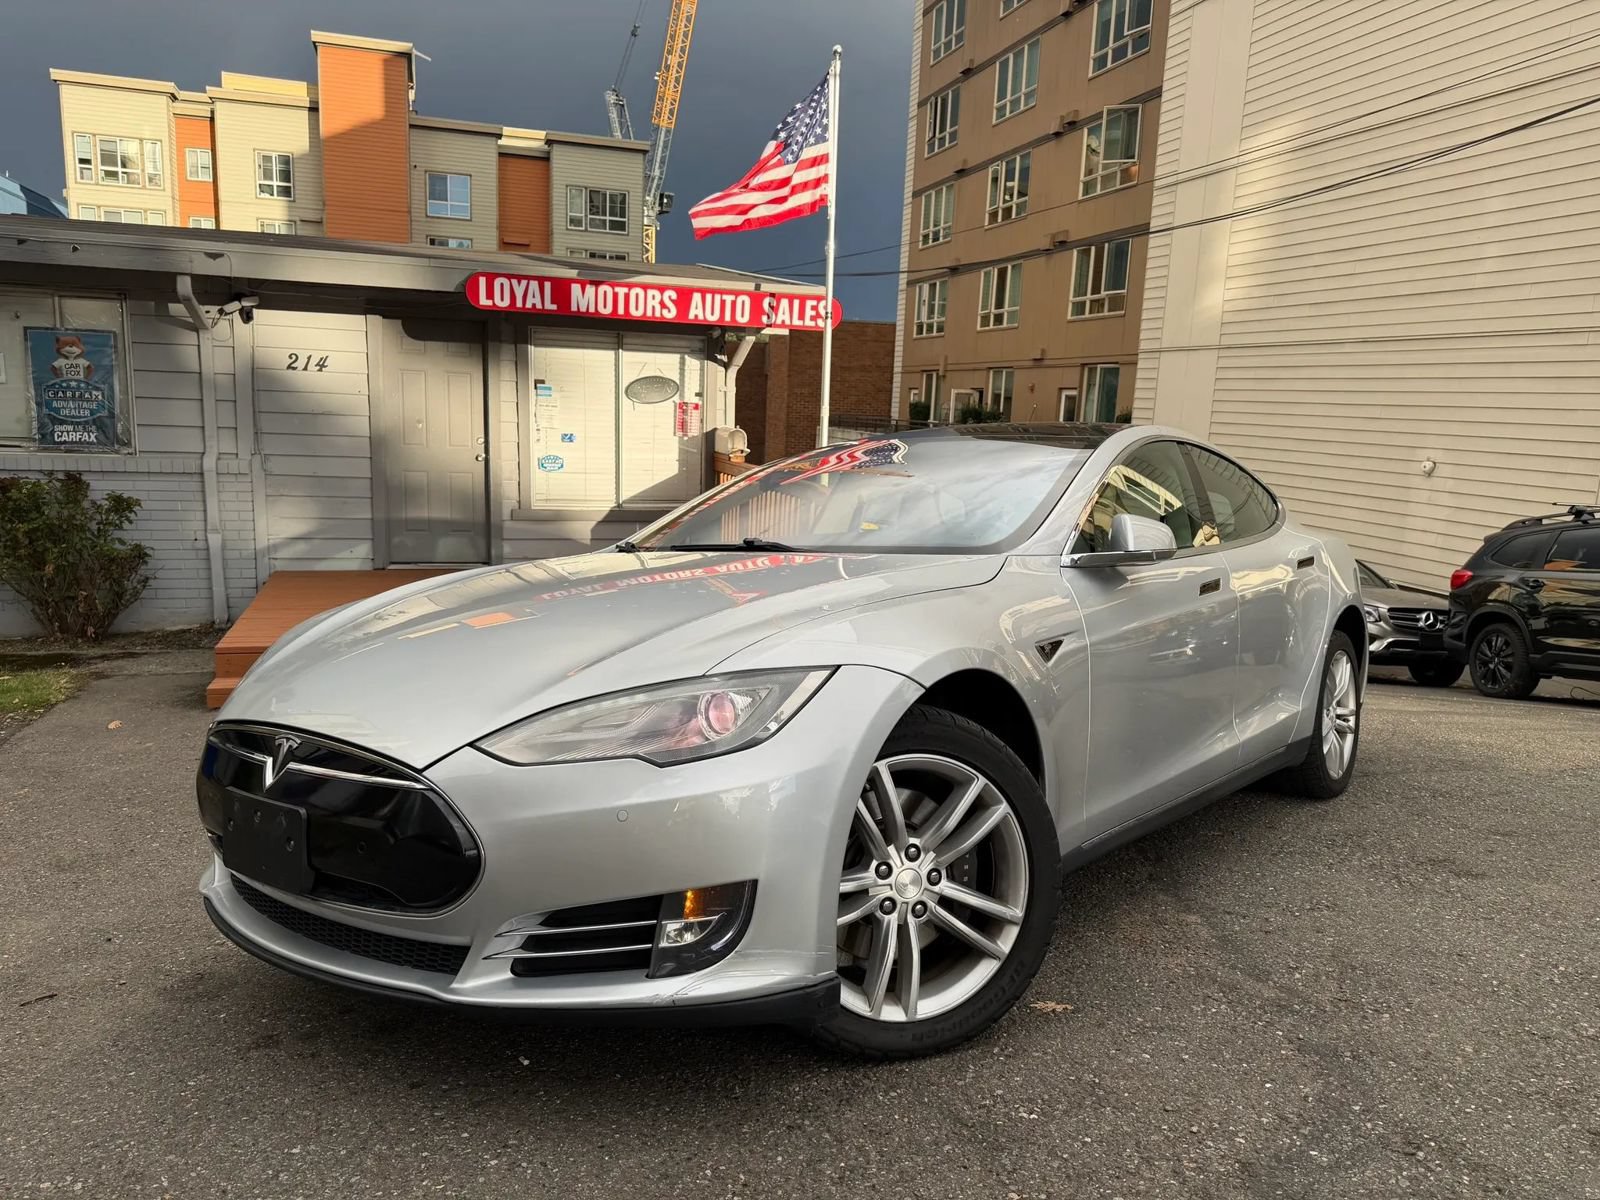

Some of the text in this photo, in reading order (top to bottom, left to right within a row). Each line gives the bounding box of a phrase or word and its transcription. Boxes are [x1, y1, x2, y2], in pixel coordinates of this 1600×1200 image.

[478, 276, 828, 329] LOYAL MOTORS AUTO SALES
[286, 353, 329, 372] 214
[48, 390, 102, 400] CARFAX
[52, 400, 98, 409] ADVANTAGE
[60, 408, 91, 417] DEALER
[54, 424, 74, 432] SHOW
[54, 431, 98, 442] CARFAX
